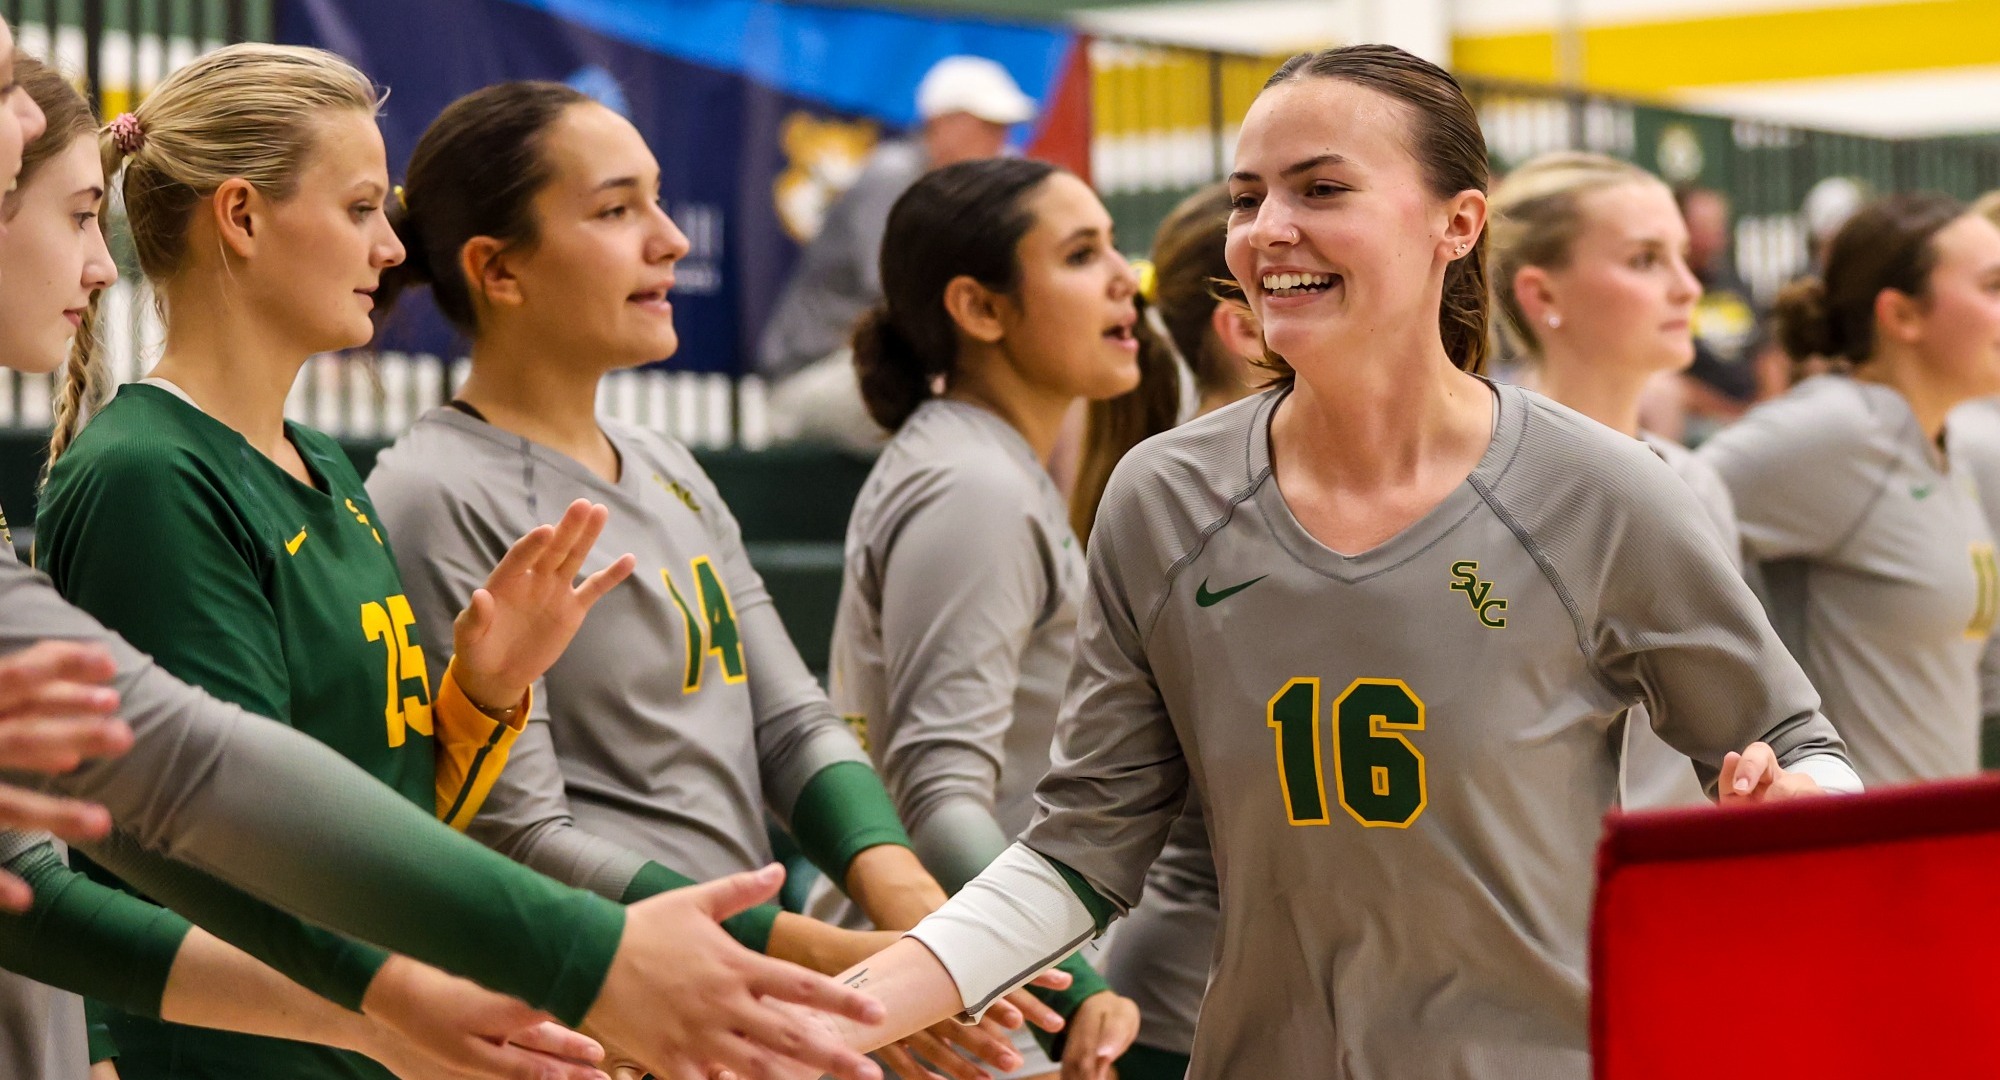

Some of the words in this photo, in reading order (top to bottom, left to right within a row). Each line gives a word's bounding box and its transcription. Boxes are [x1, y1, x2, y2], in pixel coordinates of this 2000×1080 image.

[1449, 560, 1508, 628] SVC
[361, 594, 434, 748] 25
[1267, 676, 1428, 829] 16
